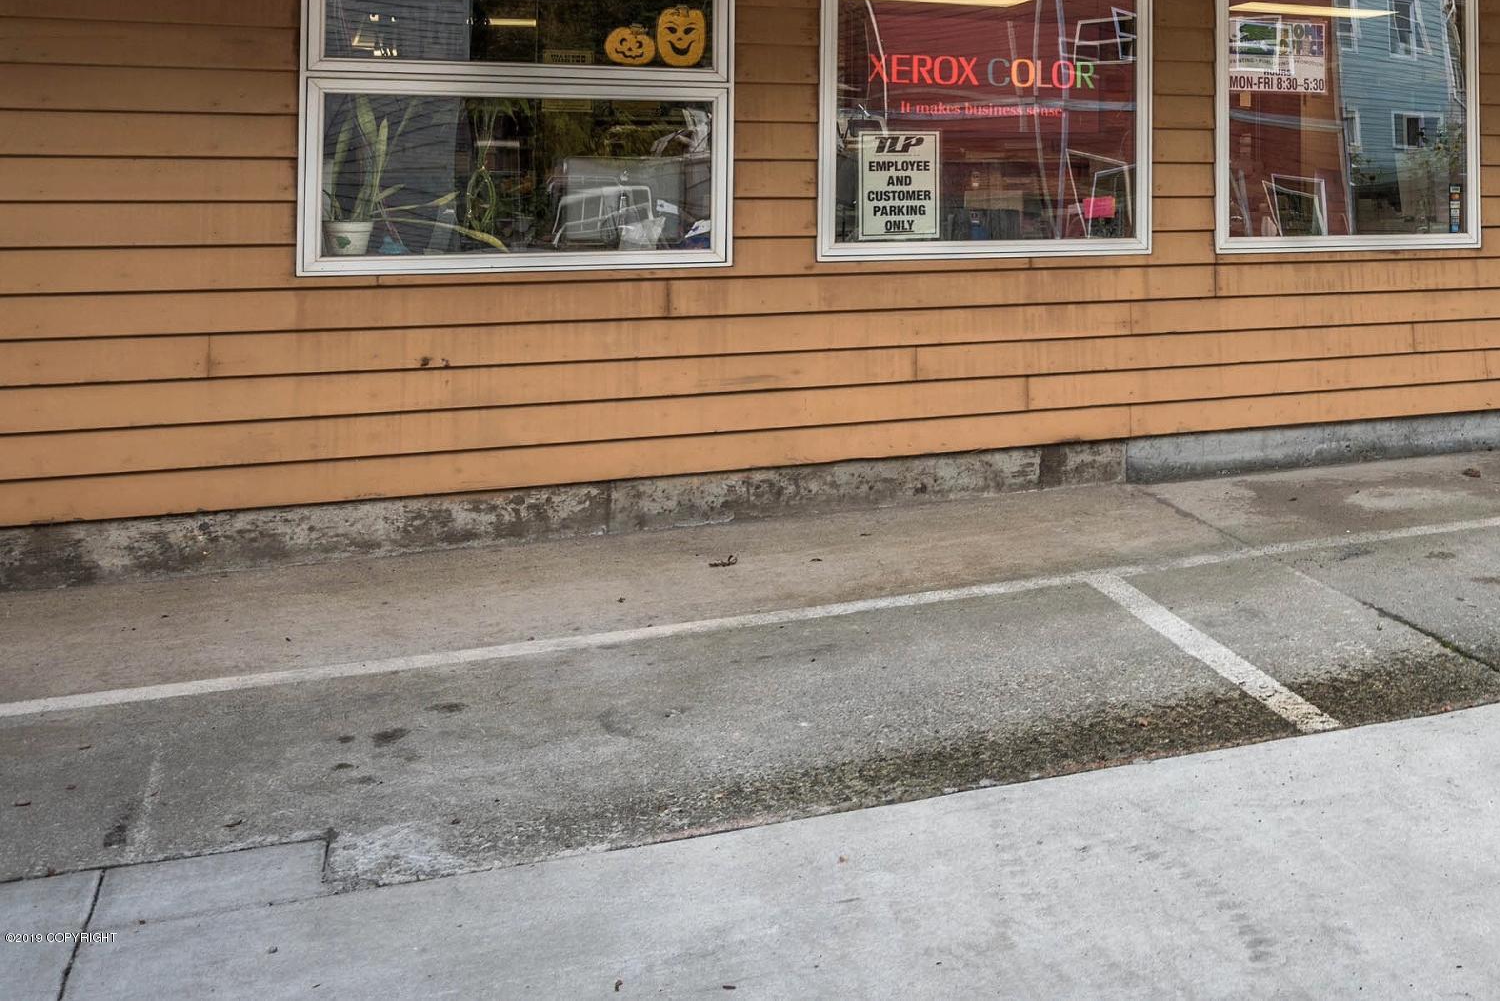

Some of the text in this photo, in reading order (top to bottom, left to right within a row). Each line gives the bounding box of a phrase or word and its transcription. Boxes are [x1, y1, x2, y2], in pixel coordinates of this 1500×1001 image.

[868, 54, 1096, 89] XEROX COLOR
[1229, 76, 1274, 90] MON-FRI
[900, 101, 912, 114] It
[916, 102, 961, 116] makes
[964, 102, 1023, 116] business
[875, 136, 924, 154] TLP
[868, 160, 931, 172] EMPLOYEE
[887, 176, 912, 186] AND
[867, 190, 932, 201] CUSTOMER
[873, 205, 926, 216] PARKING
[884, 220, 915, 231] ONLY
